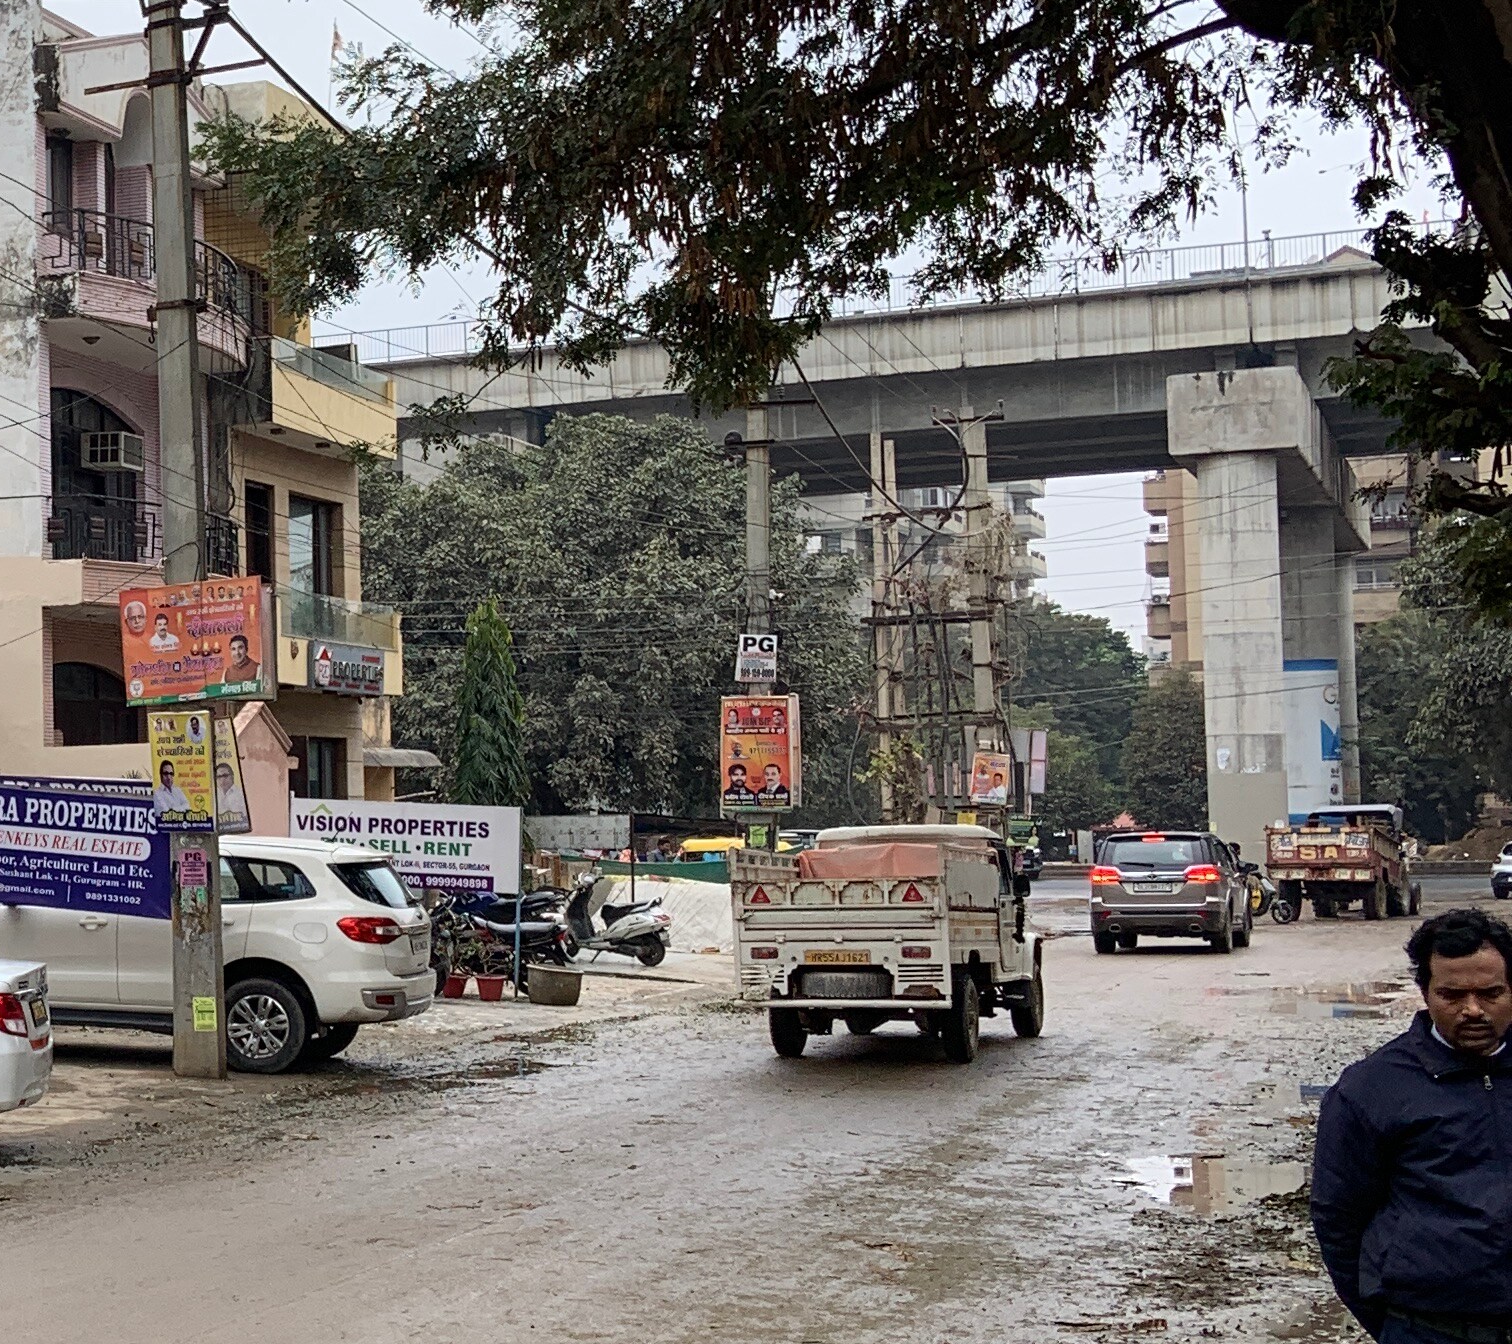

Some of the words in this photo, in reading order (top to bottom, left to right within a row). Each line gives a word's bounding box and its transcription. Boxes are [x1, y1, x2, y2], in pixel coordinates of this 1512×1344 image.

[743, 637, 774, 652] PG
[25, 798, 158, 835] PROPERTIES
[296, 815, 361, 833] VISION
[368, 818, 490, 838] PROPERTIES
[52, 837, 88, 851] REAL
[91, 839, 143, 856] ESTATE
[368, 838, 411, 854] SELL
[424, 841, 472, 856] RENT
[1324, 846, 1338, 858] A
[184, 853, 202, 861] PG
[20, 855, 89, 873] Agriculture
[93, 861, 125, 875] Land
[129, 864, 153, 878] Etc.
[459, 863, 490, 871] GURGAON
[0, 868, 34, 879] Sushant
[73, 875, 119, 887] Gurugram
[128, 881, 145, 890] HR.
[425, 877, 488, 889] 9999949898
[85, 892, 141, 904] 9891331002
